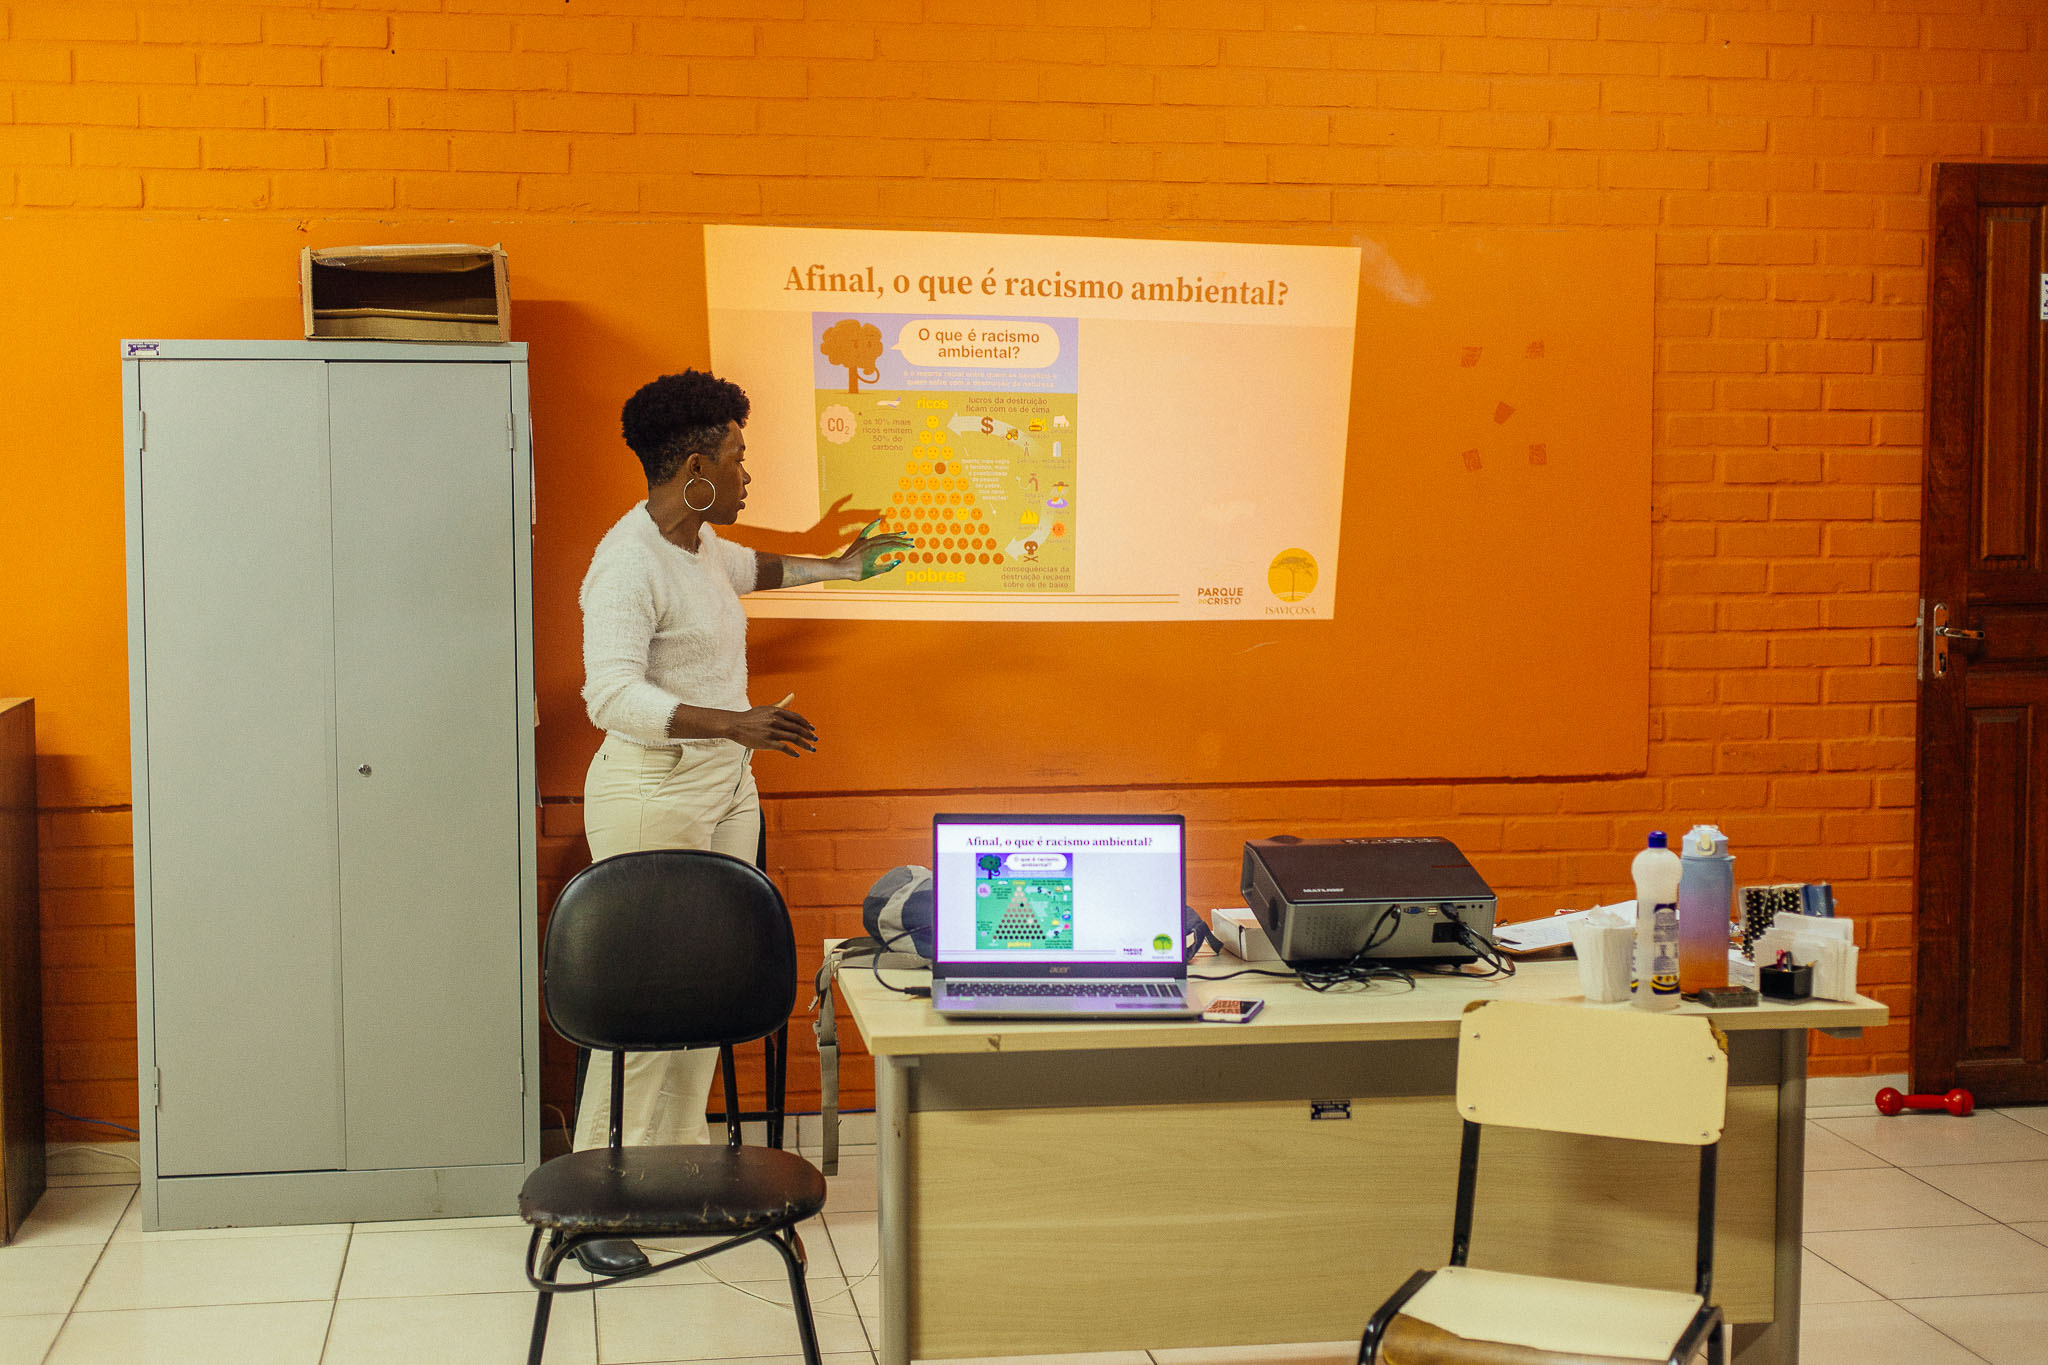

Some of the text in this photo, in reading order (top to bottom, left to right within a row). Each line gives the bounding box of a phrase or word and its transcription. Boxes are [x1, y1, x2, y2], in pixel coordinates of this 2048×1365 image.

[784, 264, 1289, 306] Afinal, o que é racismo ambiental?
[918, 328, 1040, 346] O que é racismo
[938, 345, 1020, 359] ambiental?
[916, 396, 949, 409] ricos
[994, 397, 1004, 405] da
[1006, 397, 1048, 406] destruição
[1031, 406, 1050, 414] cima
[1002, 565, 1070, 574] consequências da
[905, 567, 966, 586] pobres
[1001, 573, 1041, 582] destruição
[1003, 581, 1025, 589] sobre
[1037, 581, 1047, 589] de
[1197, 587, 1244, 597] PARQUE
[1207, 597, 1242, 606] CRISTO
[966, 837, 1002, 848] Afinal,
[1014, 839, 1035, 848] que
[1037, 836, 1043, 846] é
[1046, 837, 1090, 847] racismo
[1092, 837, 1153, 847] ambiental?
[1049, 966, 1070, 974] acer
